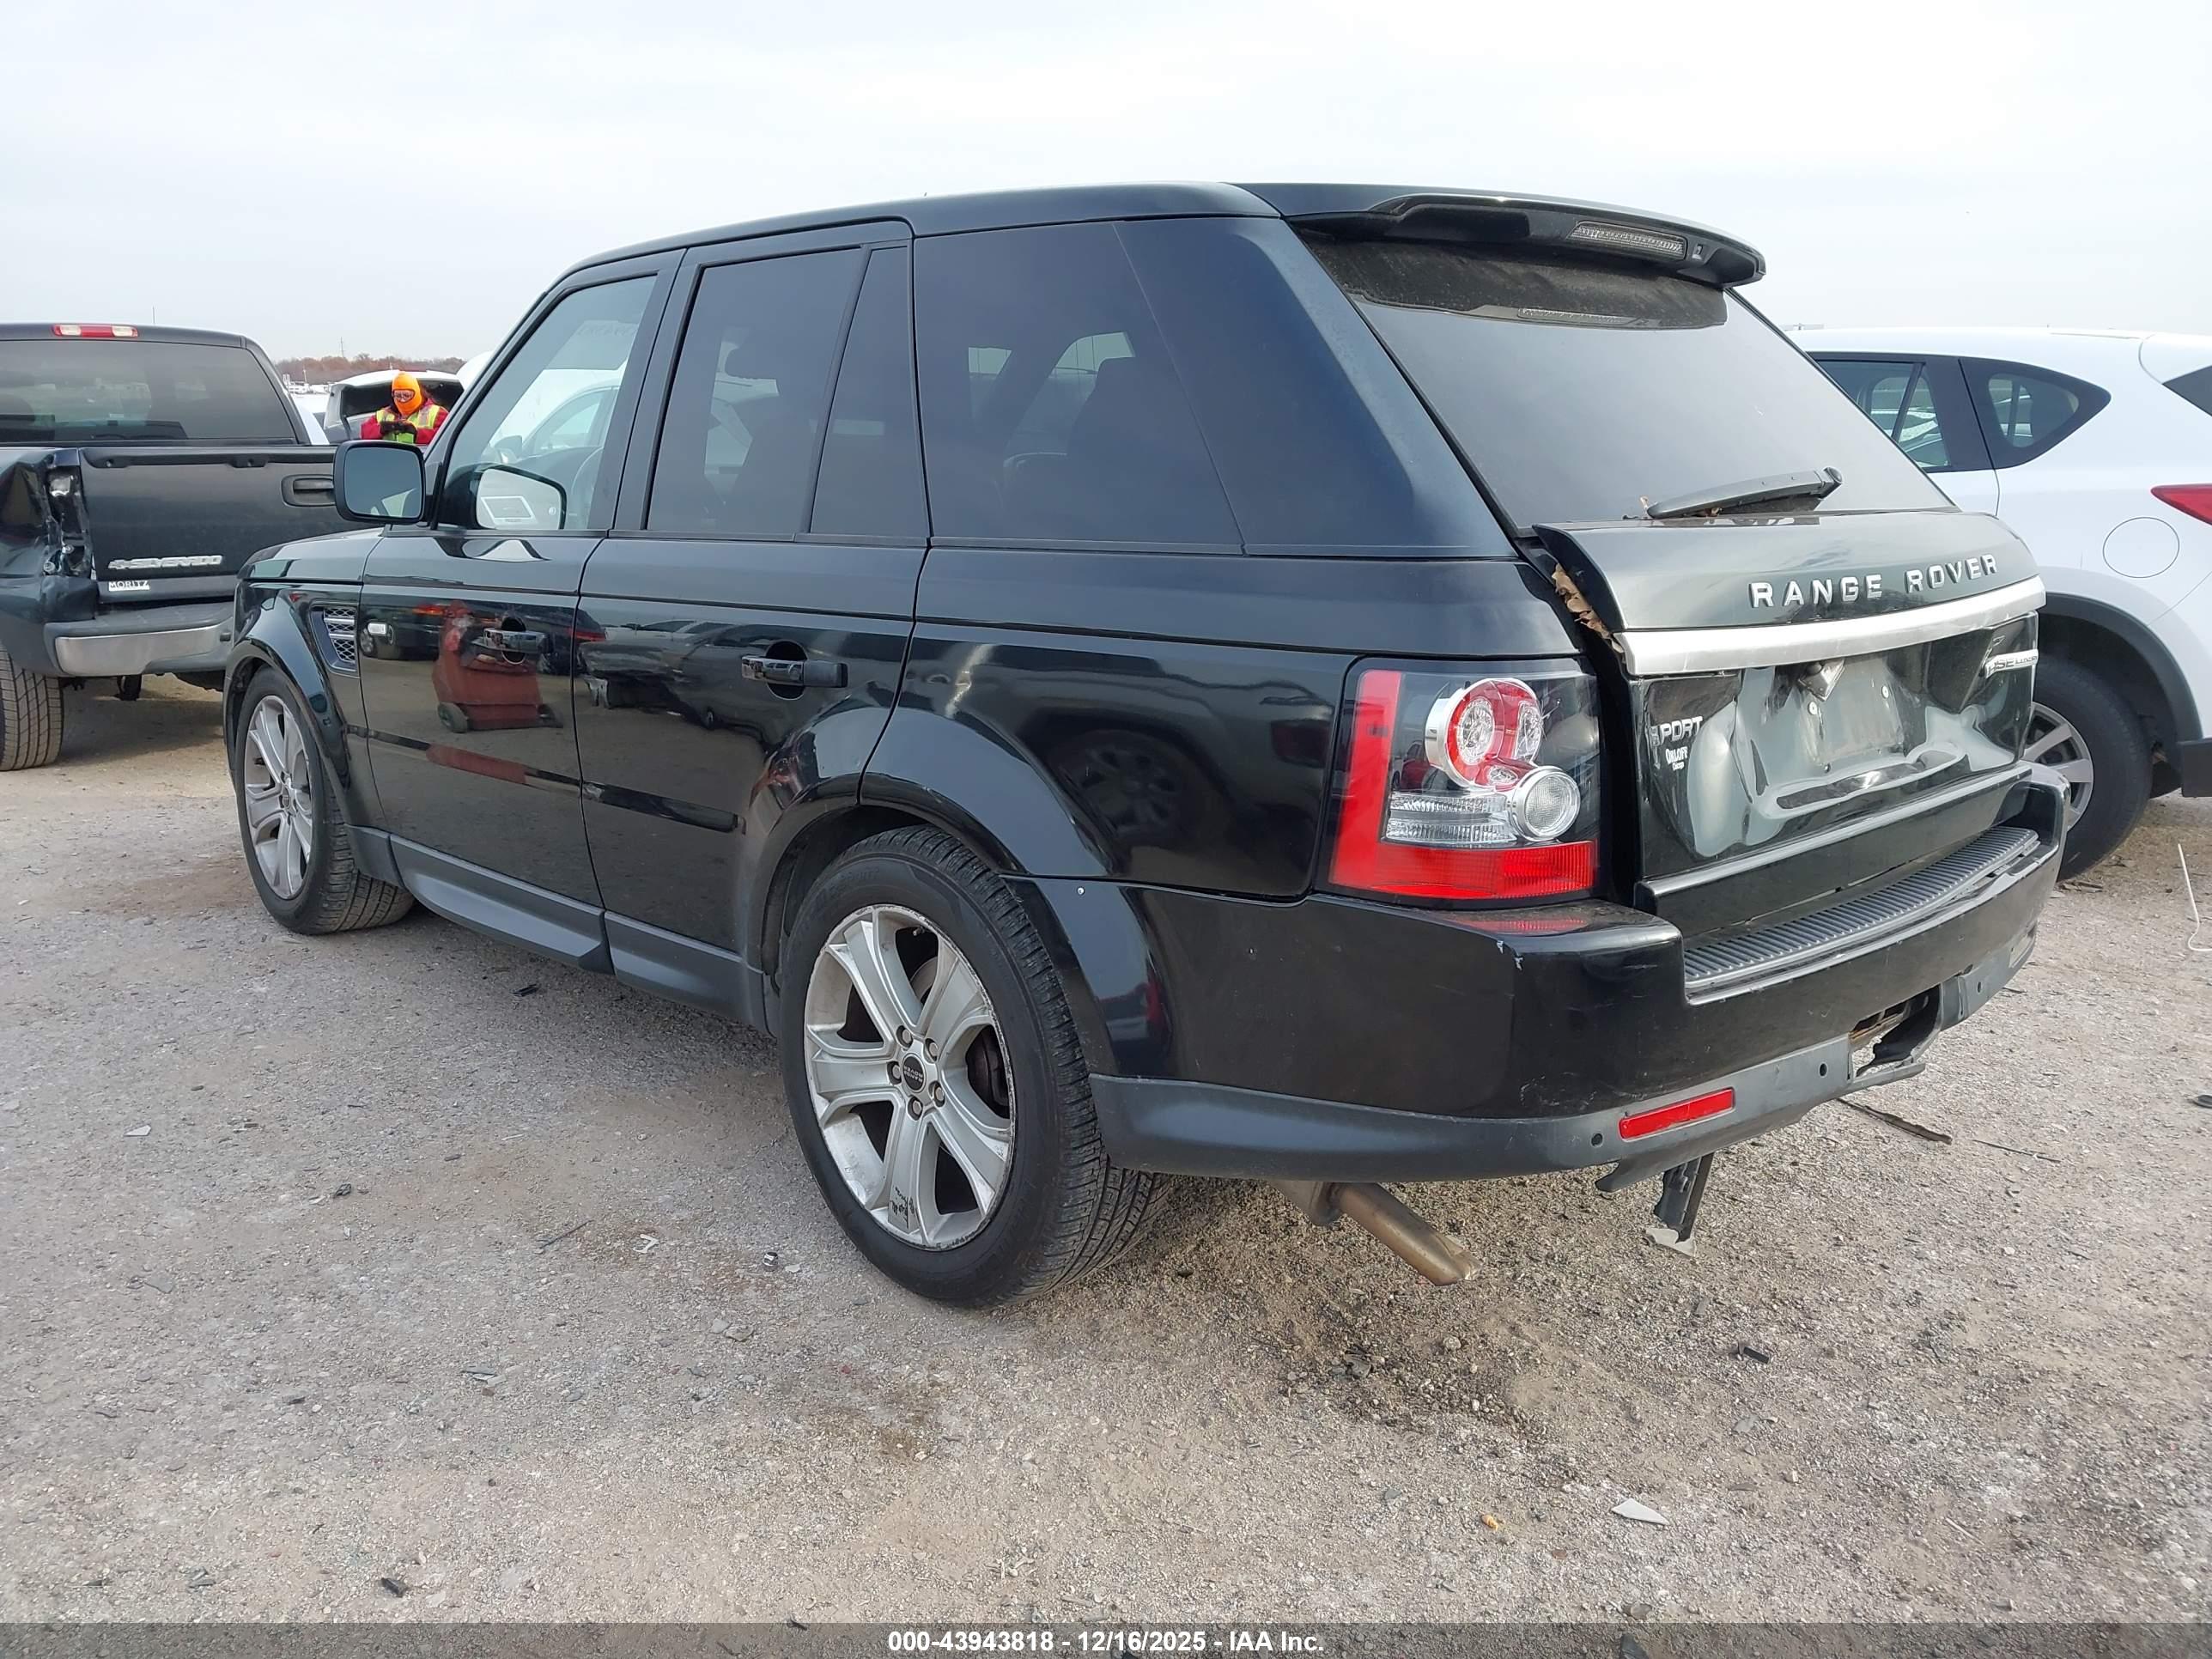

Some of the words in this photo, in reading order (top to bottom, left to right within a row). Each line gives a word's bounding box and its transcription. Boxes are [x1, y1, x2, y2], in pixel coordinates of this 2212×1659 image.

[108, 580, 150, 588] MORITZ
[1749, 574, 1883, 608] RANGE
[1904, 554, 1998, 593] ROVER
